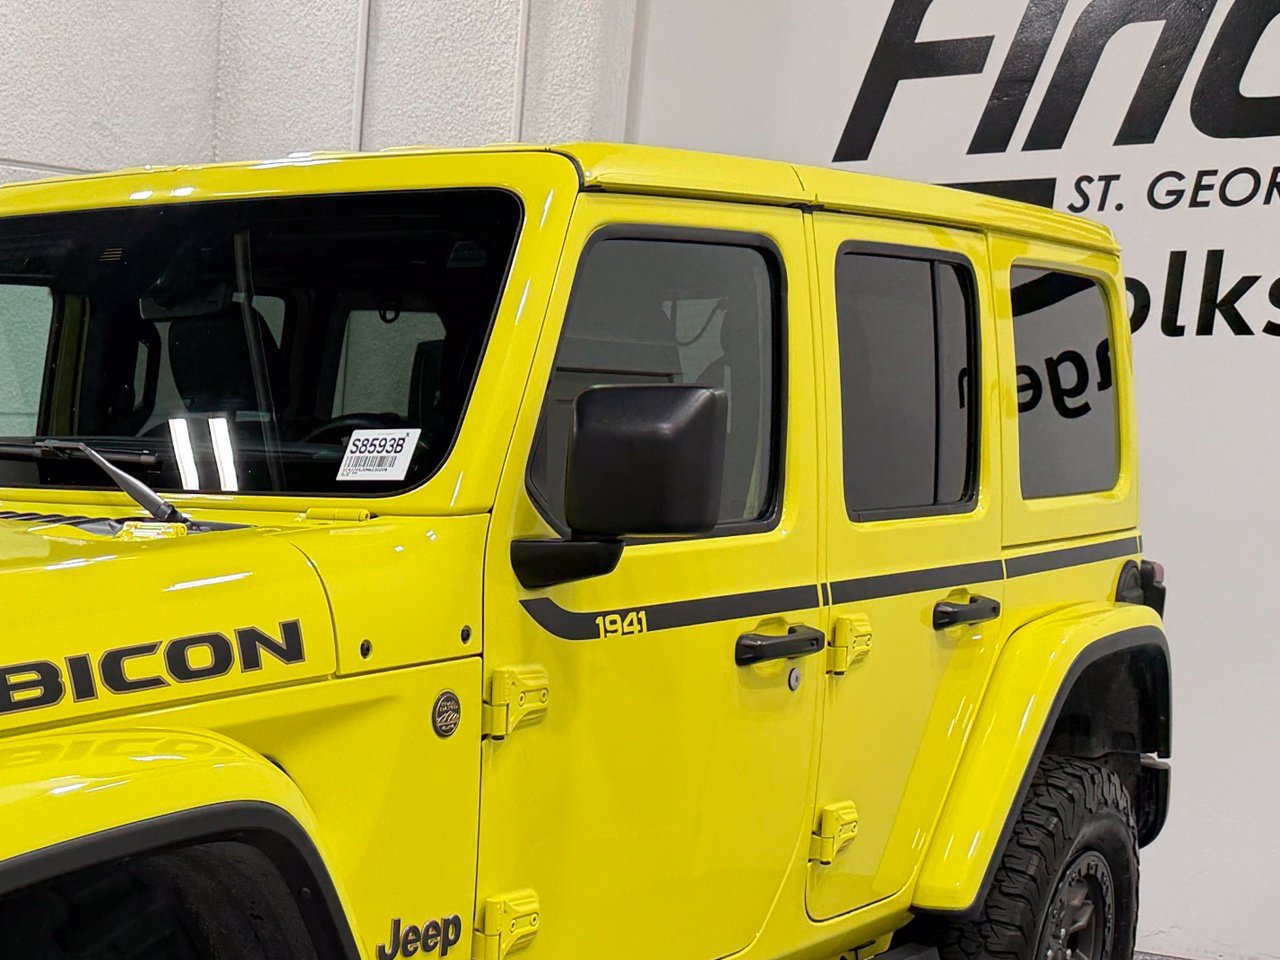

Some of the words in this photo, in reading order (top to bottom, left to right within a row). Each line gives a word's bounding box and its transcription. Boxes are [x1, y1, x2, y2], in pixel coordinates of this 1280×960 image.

[1067, 174, 1124, 213] ST.
[350, 438, 405, 455] S8593B
[595, 610, 648, 640] 1941
